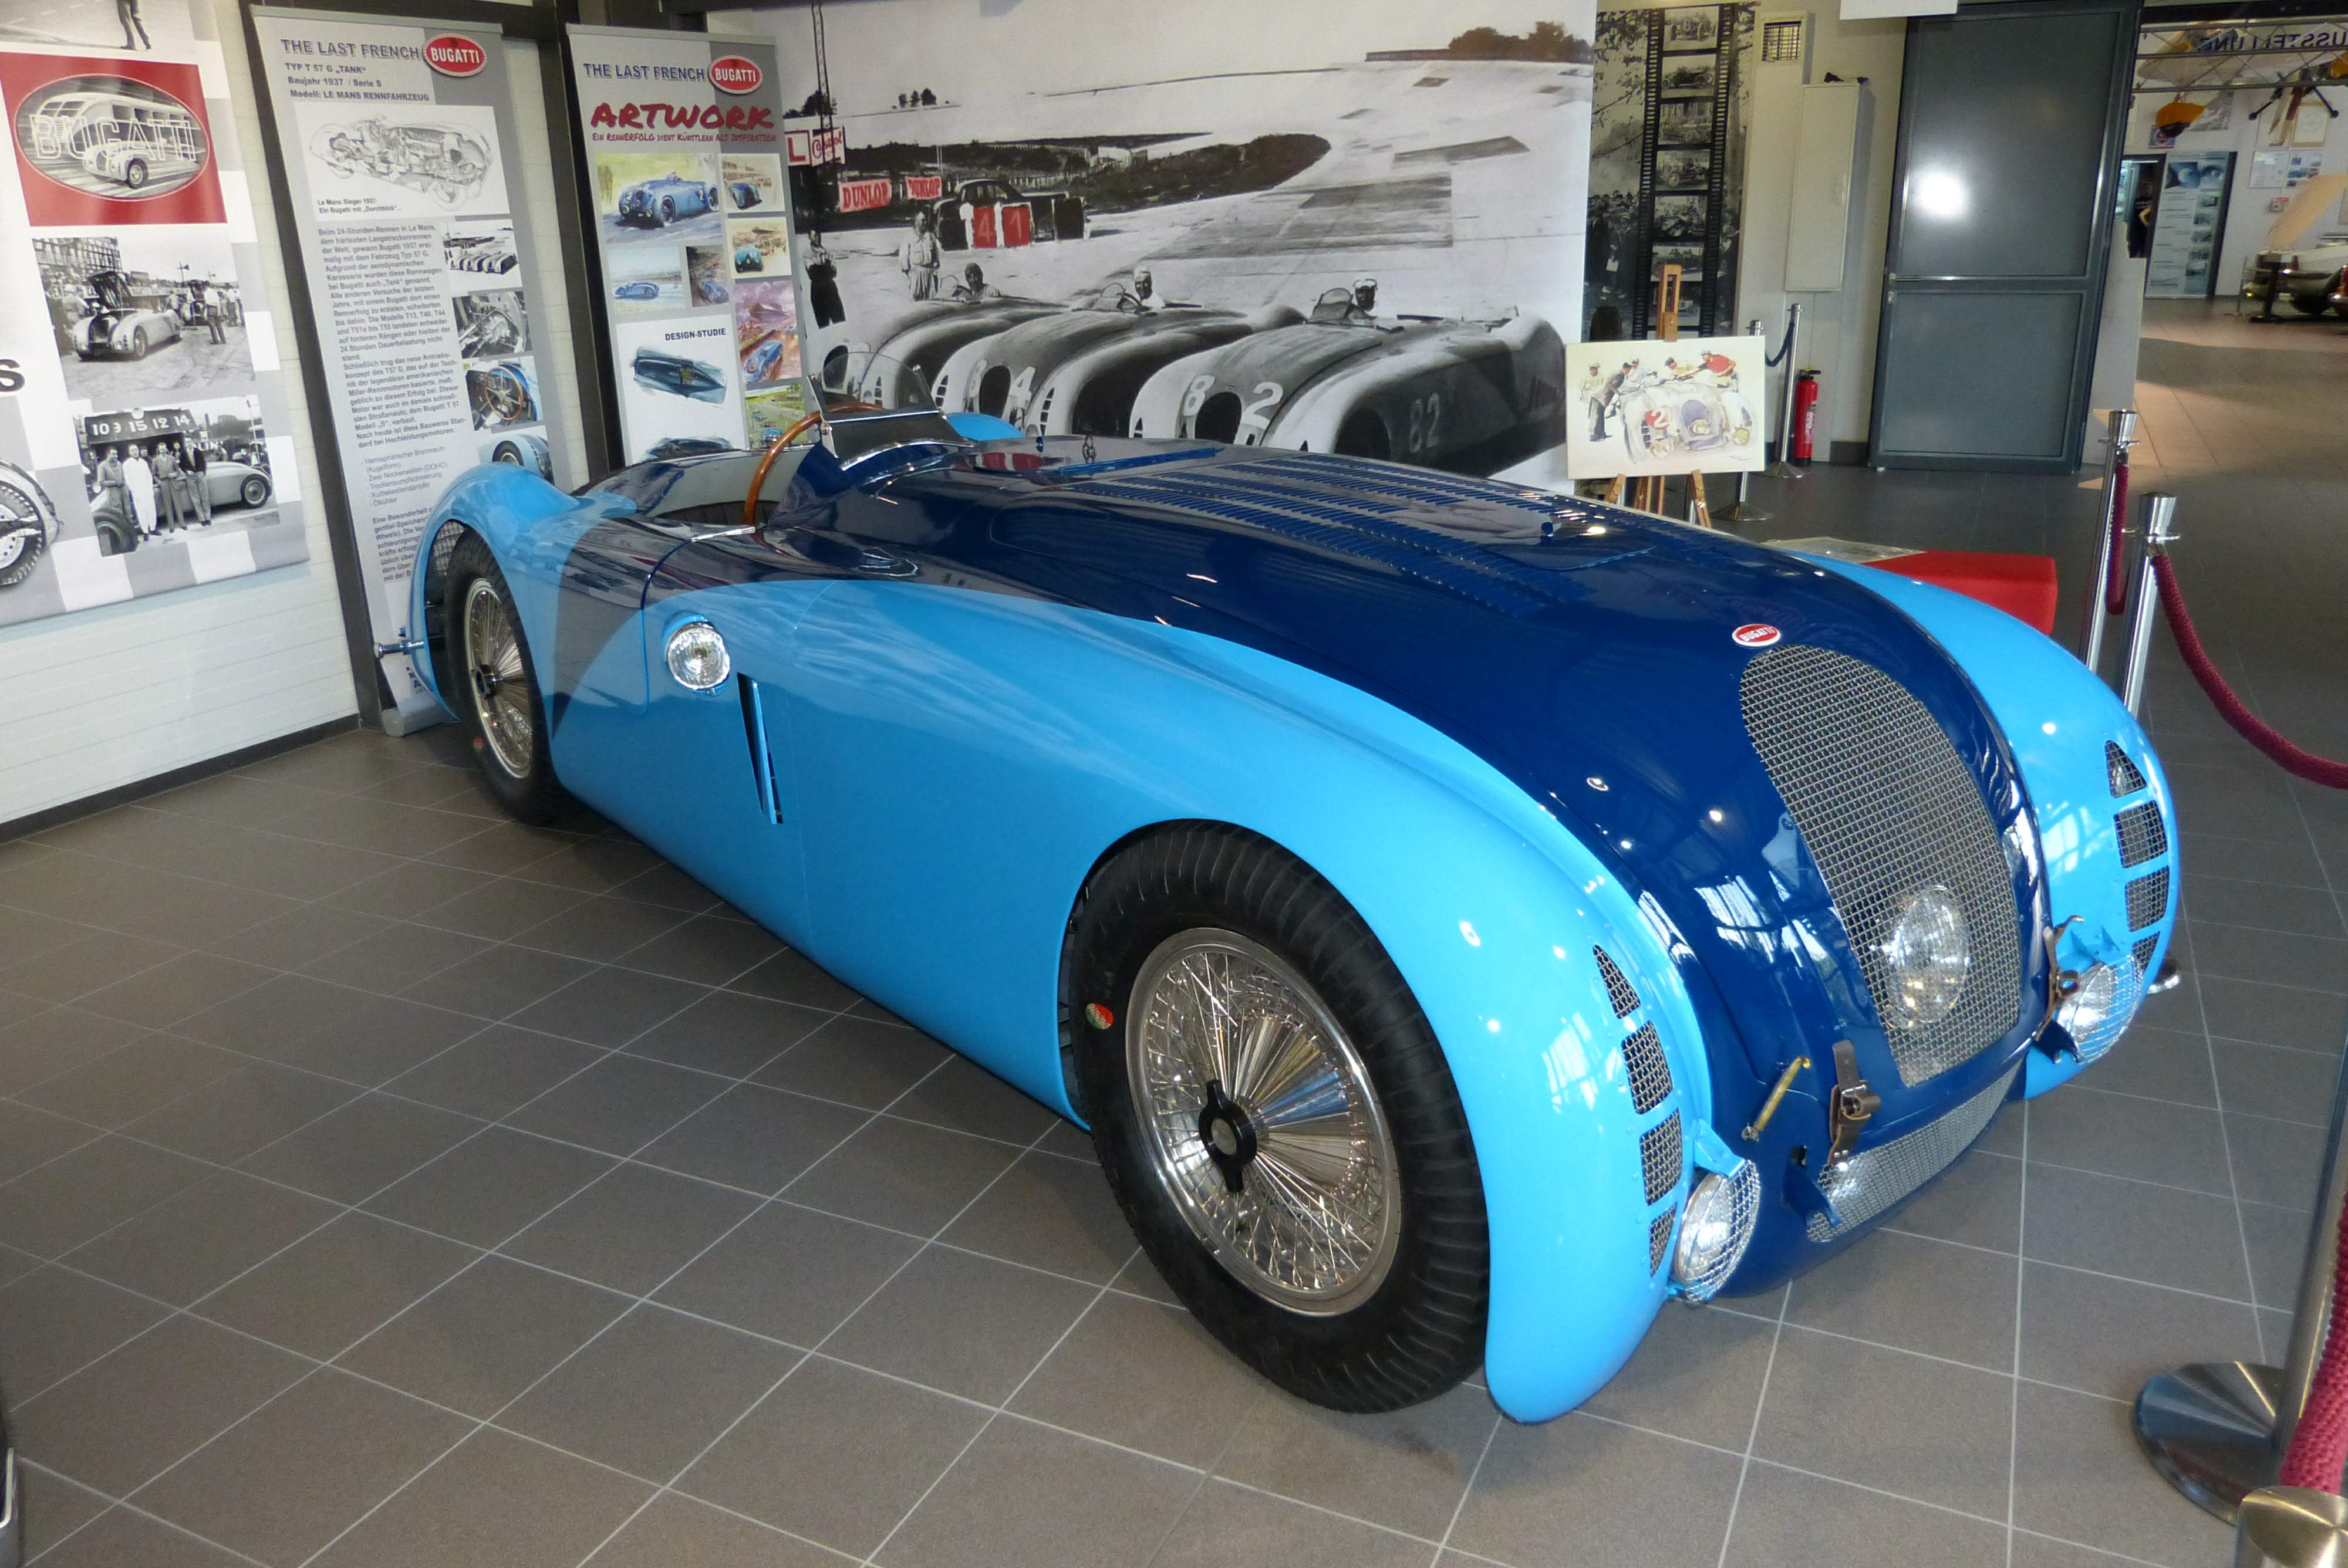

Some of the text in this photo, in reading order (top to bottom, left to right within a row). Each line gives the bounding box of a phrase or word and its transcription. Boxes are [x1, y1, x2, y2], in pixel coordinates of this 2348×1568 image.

[281, 39, 420, 59] THE LAST FRENCH
[431, 46, 480, 64] BUGATTI
[305, 63, 311, 72] T
[313, 64, 323, 72] 57
[583, 63, 705, 80] THE LAST FRENCH
[715, 67, 757, 82] BUGATTI
[288, 76, 321, 86] Baujahr
[323, 77, 343, 86] 1937
[336, 91, 362, 99] MANS
[363, 92, 430, 101] RENNFAHRZEUG
[591, 103, 774, 130] ARTWORK
[29, 114, 197, 161] BUGATTI
[842, 181, 889, 208] DUNLOP
[908, 178, 940, 198] DUNLOP
[665, 328, 726, 340] DESIGN-STUDIE
[1242, 381, 1284, 430] 2
[93, 423, 110, 436] 10
[128, 420, 148, 432] 15
[151, 417, 170, 430] 12
[174, 414, 191, 426] 14
[1651, 407, 1671, 428] 2
[1738, 626, 1776, 642] BUGATTI
